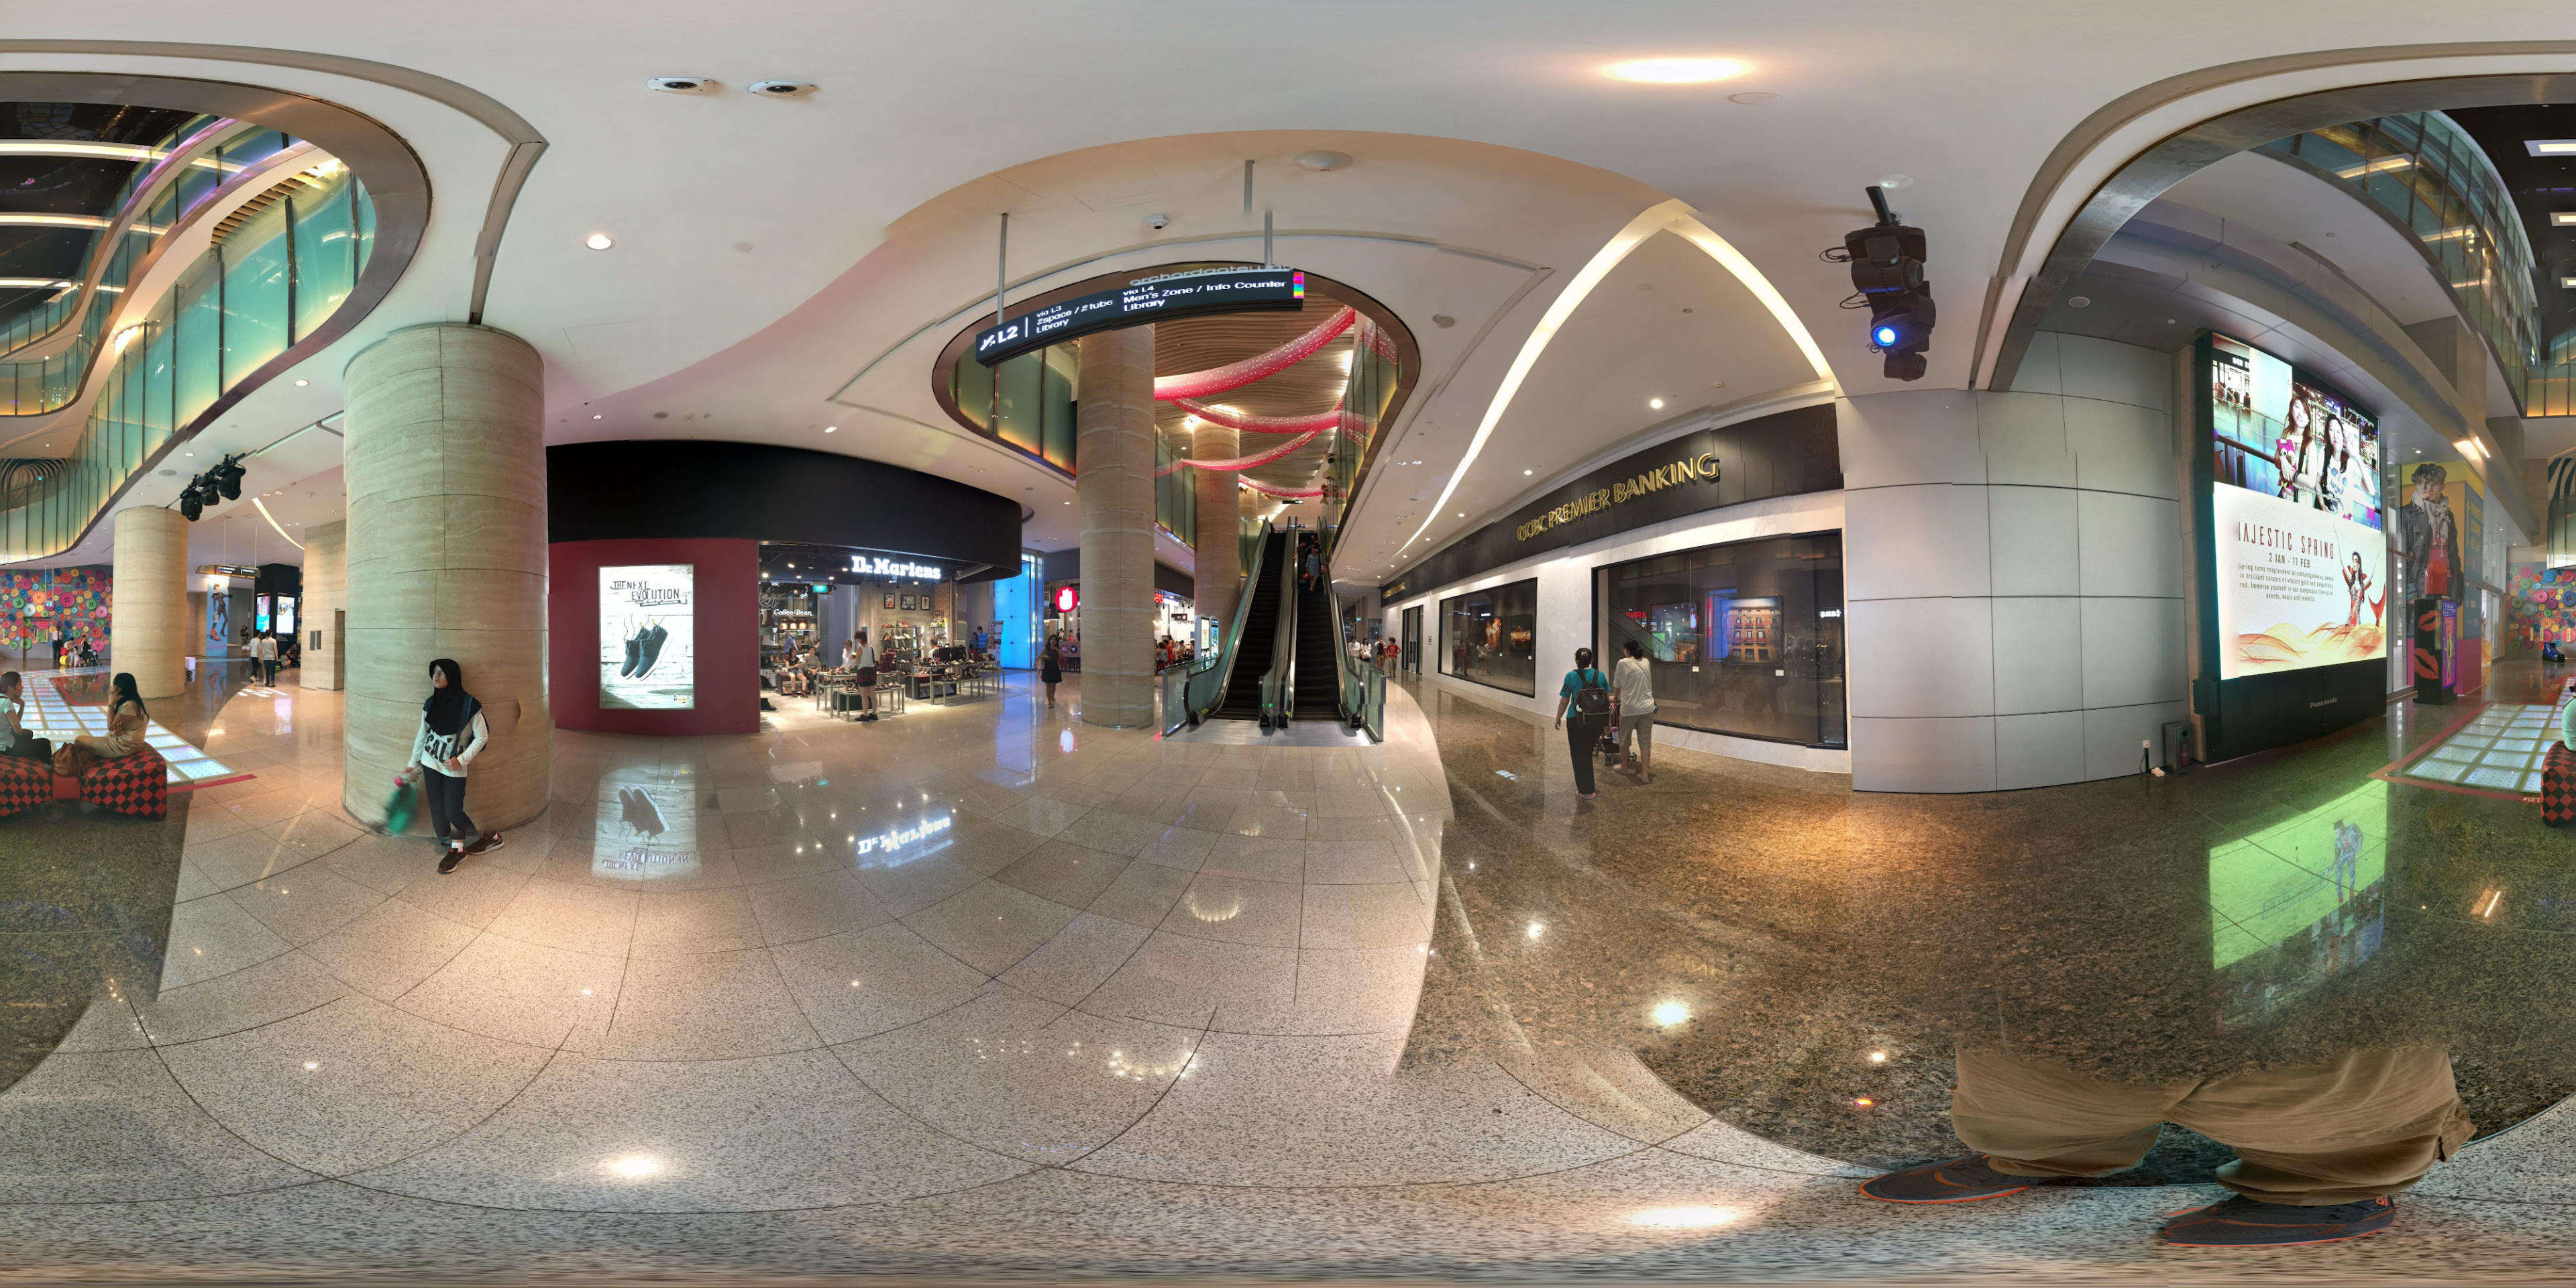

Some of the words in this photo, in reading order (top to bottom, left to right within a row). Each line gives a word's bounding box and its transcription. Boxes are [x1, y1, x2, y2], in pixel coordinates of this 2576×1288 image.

[1124, 292, 1159, 303] Men's
[1163, 286, 1193, 297] Zone
[1206, 283, 1230, 292] Info
[1234, 280, 1287, 289] Counter
[1051, 305, 1063, 313] L3
[1124, 299, 1165, 312] Library
[1036, 319, 1069, 333] Library
[998, 325, 1018, 343] L2
[1517, 515, 1548, 542] OCBC
[1548, 488, 1611, 527] PREMIER
[1613, 452, 1720, 504] BANKING
[2301, 535, 2334, 559] SPRING
[2239, 563, 2253, 572] Spring
[2269, 553, 2272, 562] 2
[2275, 553, 2286, 564] JAN
[2293, 557, 2298, 566] 11
[2300, 558, 2310, 568] FEB
[873, 558, 941, 579] Martens
[612, 581, 626, 590] THE
[2310, 698, 2338, 708] Panasonic
